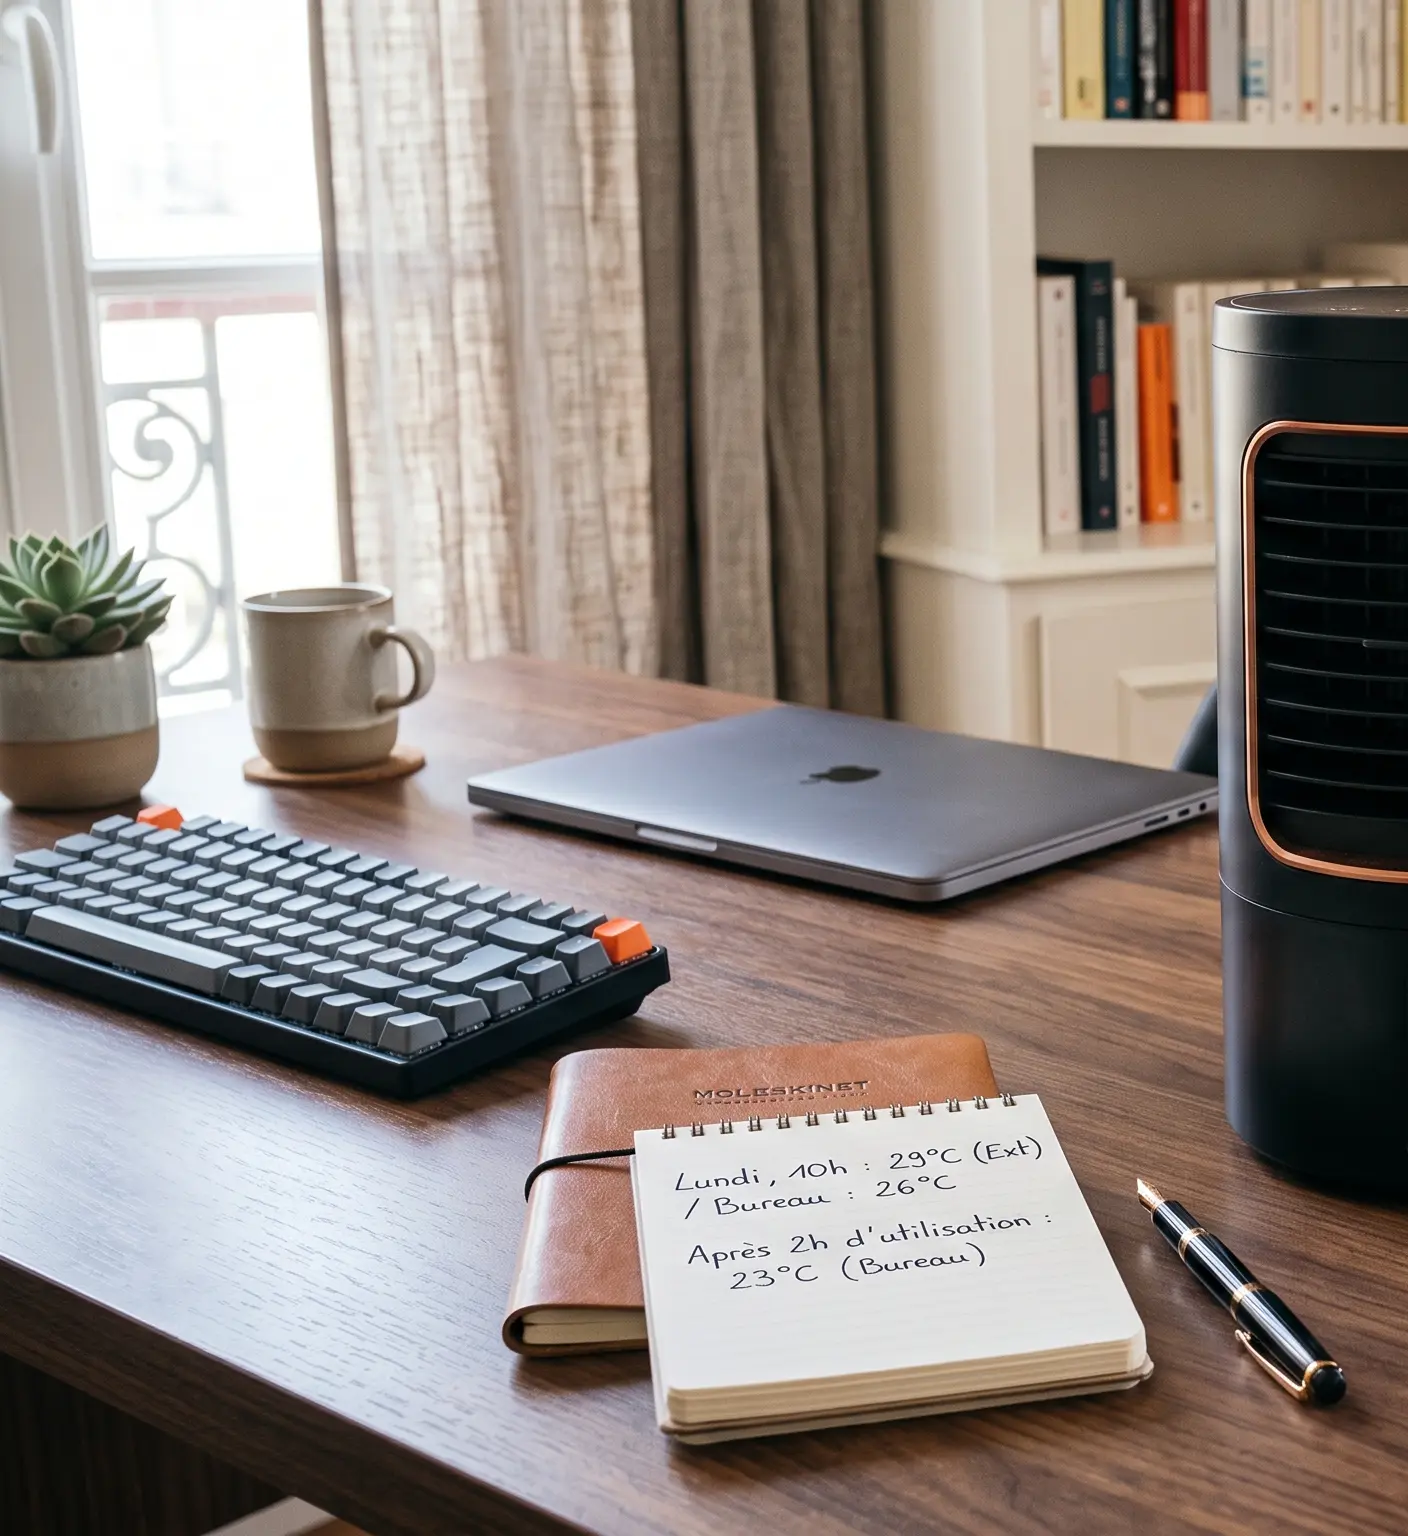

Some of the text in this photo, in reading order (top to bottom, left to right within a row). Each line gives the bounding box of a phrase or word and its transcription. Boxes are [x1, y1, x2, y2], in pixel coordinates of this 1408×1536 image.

[694, 1080, 871, 1099] MOLESKINET
[788, 1159, 848, 1179] 10h
[889, 1148, 963, 1170] 29°C
[973, 1135, 1042, 1165] (Ext)
[713, 1194, 831, 1216] Bureau
[875, 1174, 957, 1198] 26°C
[687, 1241, 771, 1270] Après
[790, 1233, 828, 1253] 2h
[846, 1214, 1032, 1248] d'utilisation
[730, 1242, 986, 1290] 23°C (Bureau)
